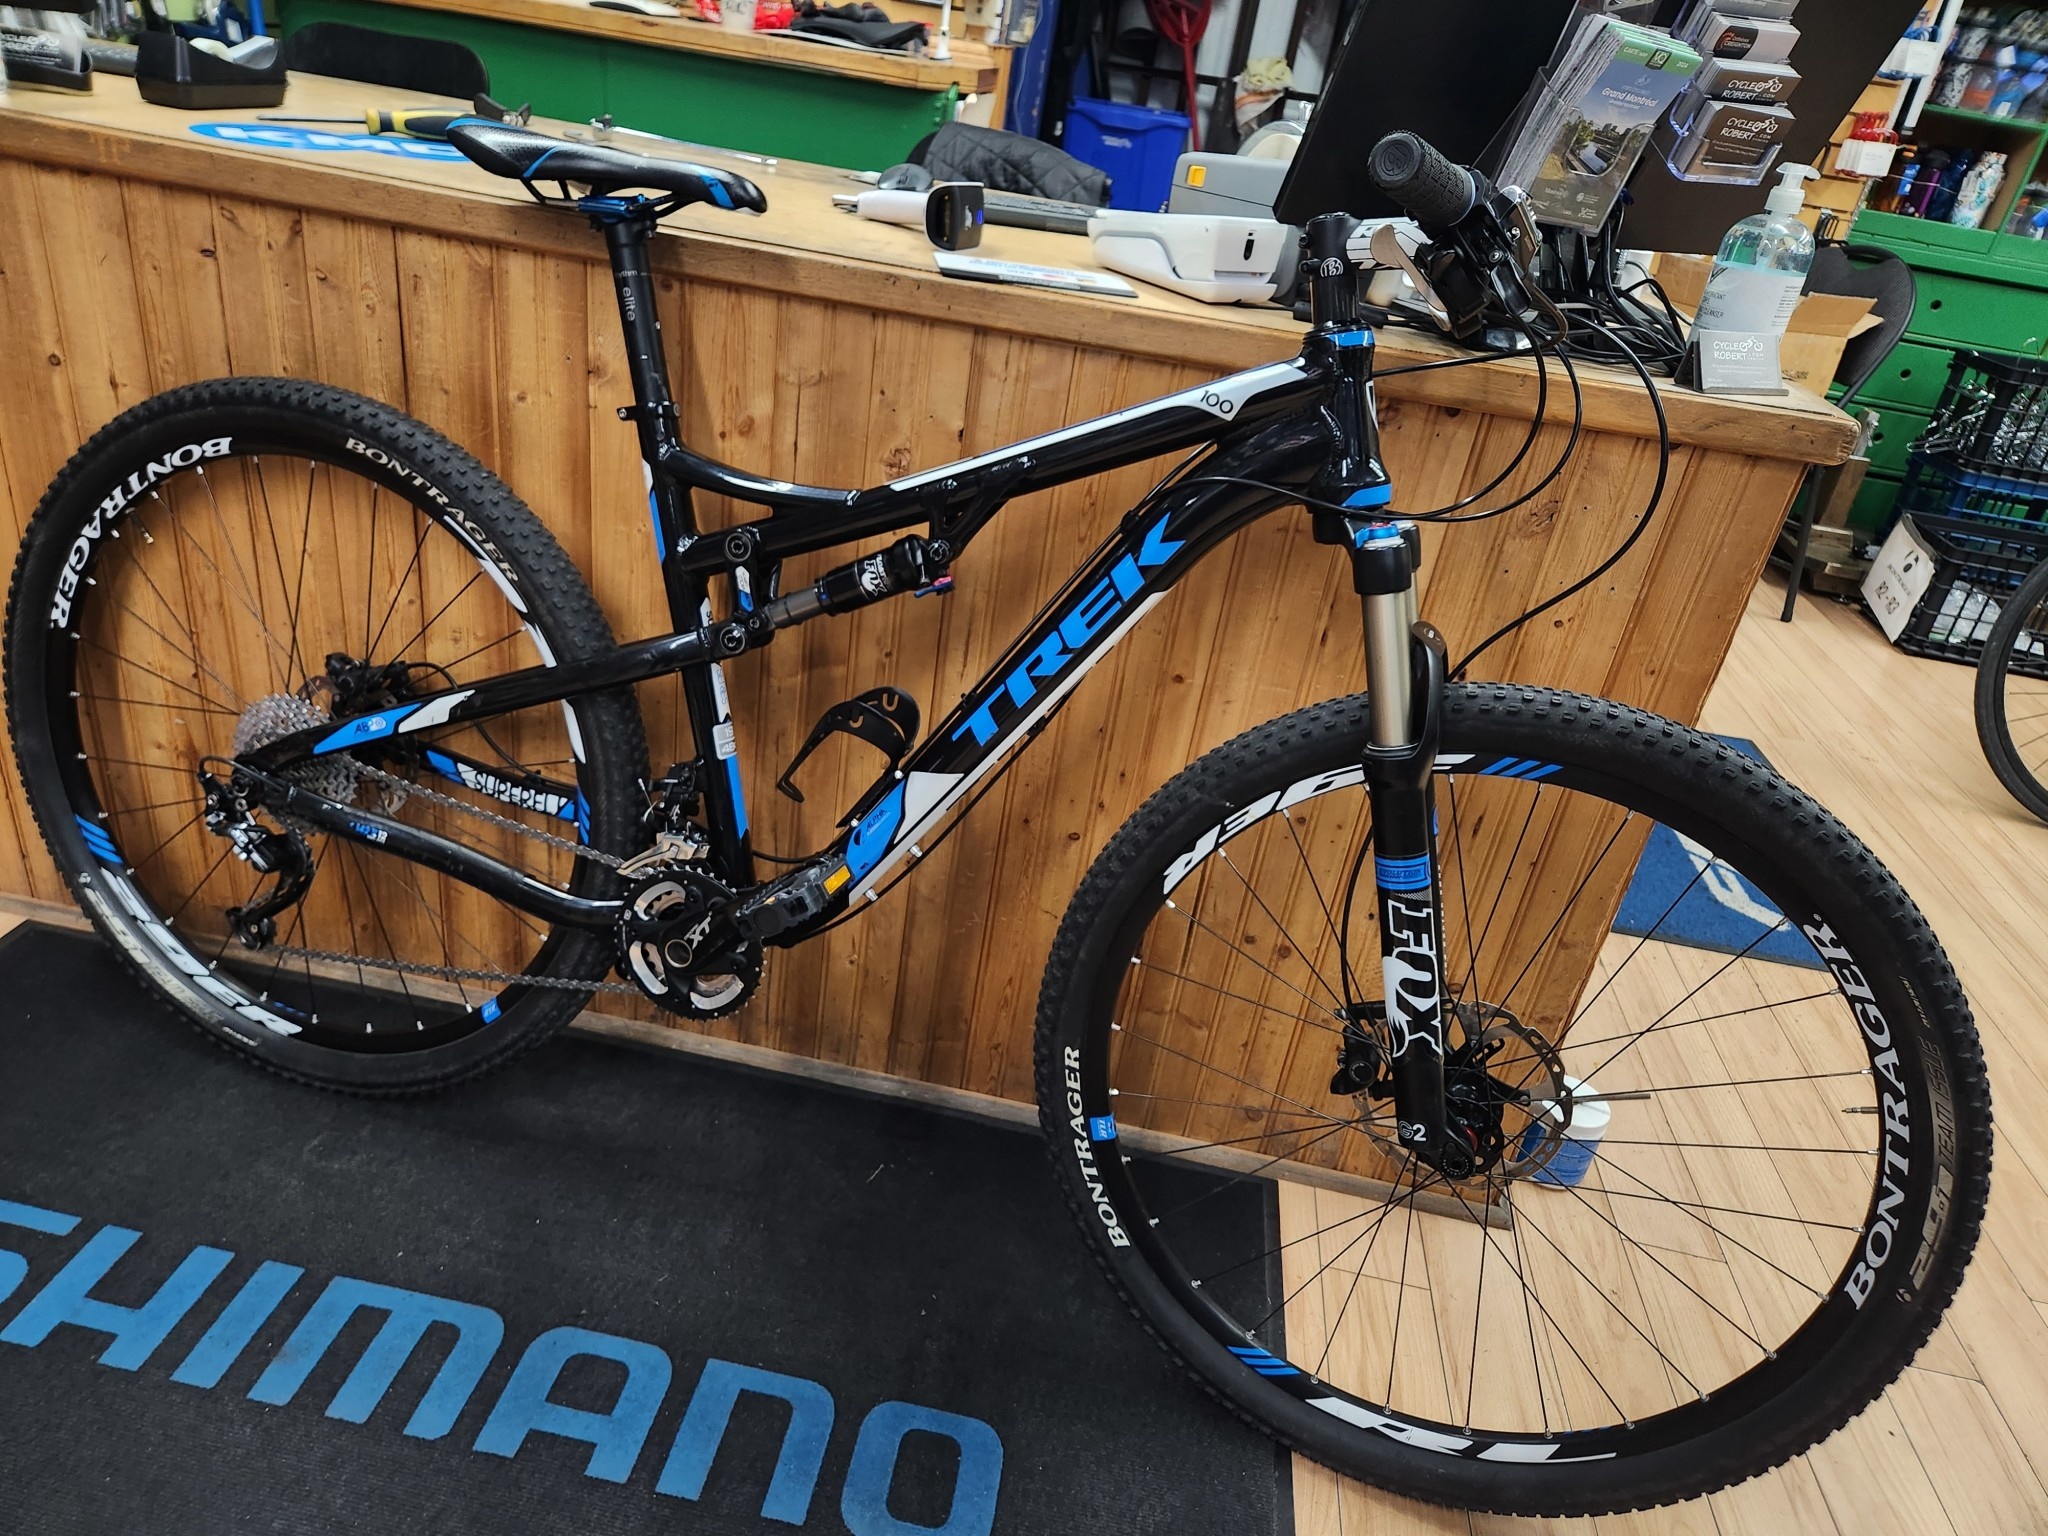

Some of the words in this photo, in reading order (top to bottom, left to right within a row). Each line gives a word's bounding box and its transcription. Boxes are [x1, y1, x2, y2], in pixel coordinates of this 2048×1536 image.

[1602, 87, 1626, 100] Grand
[1721, 89, 1758, 100] ROBERT
[1728, 79, 1757, 90] CYCLE
[1720, 127, 1756, 141] ROBERT
[1726, 117, 1754, 129] CYCLE
[622, 287, 637, 321] elite
[1713, 340, 1741, 350] CYCLE
[1714, 350, 1748, 361] ROBERT
[1200, 389, 1234, 414] 100
[344, 436, 519, 585] BONTRAGER
[48, 436, 234, 631] BONTRAGER
[861, 559, 889, 597] FOX
[951, 511, 1186, 747] TREK
[1382, 898, 1444, 1059] FOX
[1803, 921, 1912, 1312] BONTRAGER
[1934, 1101, 1954, 1164] TEAM
[1061, 1045, 1131, 1251] BONTRAGER
